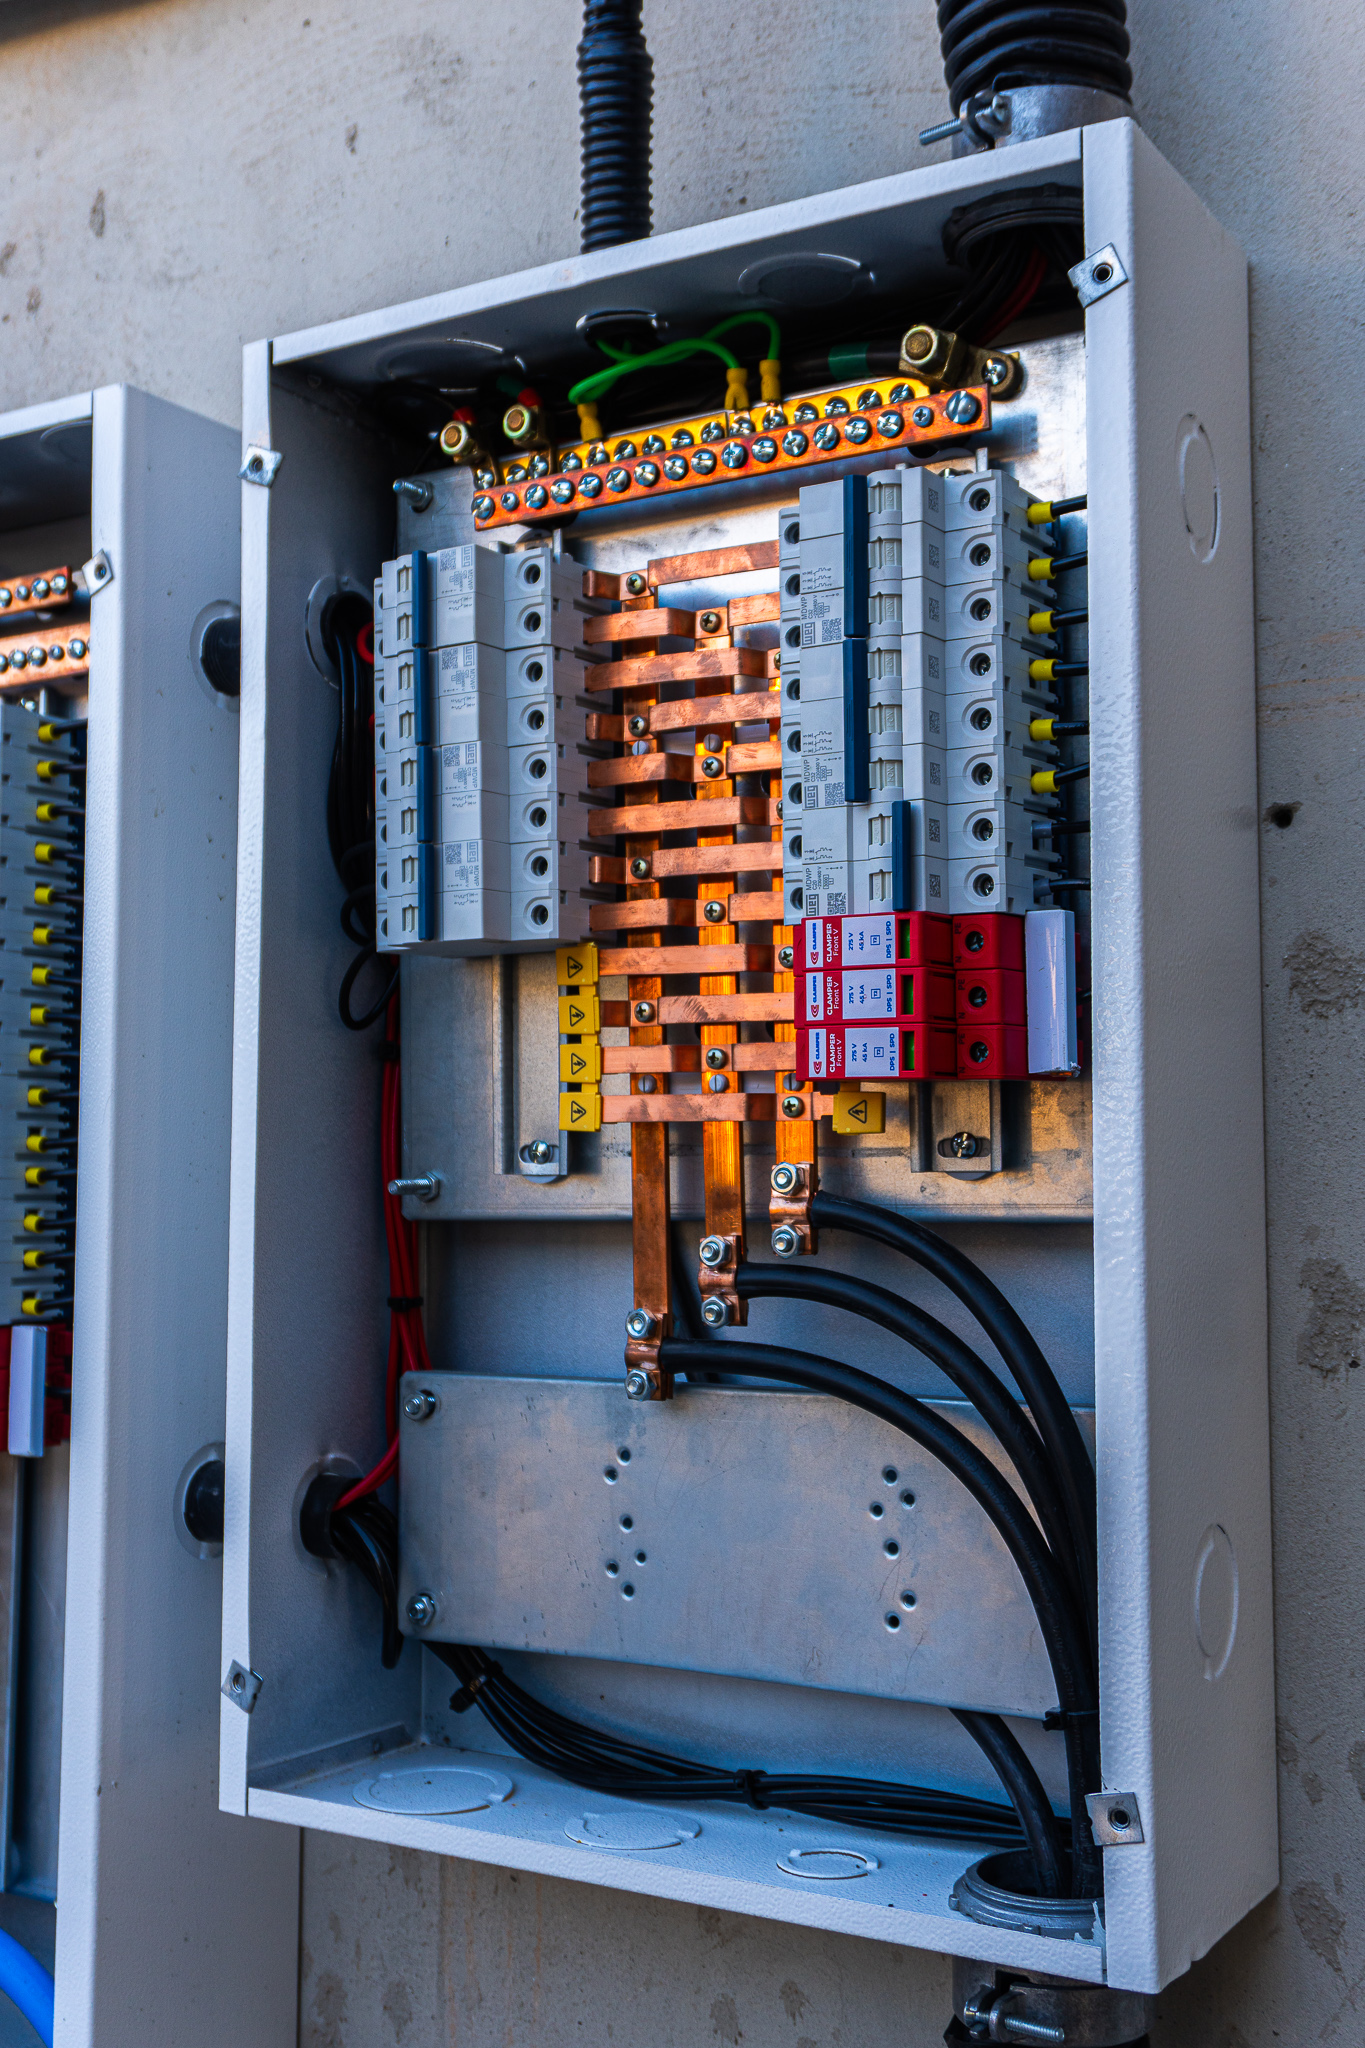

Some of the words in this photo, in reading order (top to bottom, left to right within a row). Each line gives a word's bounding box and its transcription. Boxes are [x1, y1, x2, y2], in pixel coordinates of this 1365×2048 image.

[859, 931, 864, 941] kA
[860, 985, 864, 994] kA
[862, 1043, 867, 1052] kA
